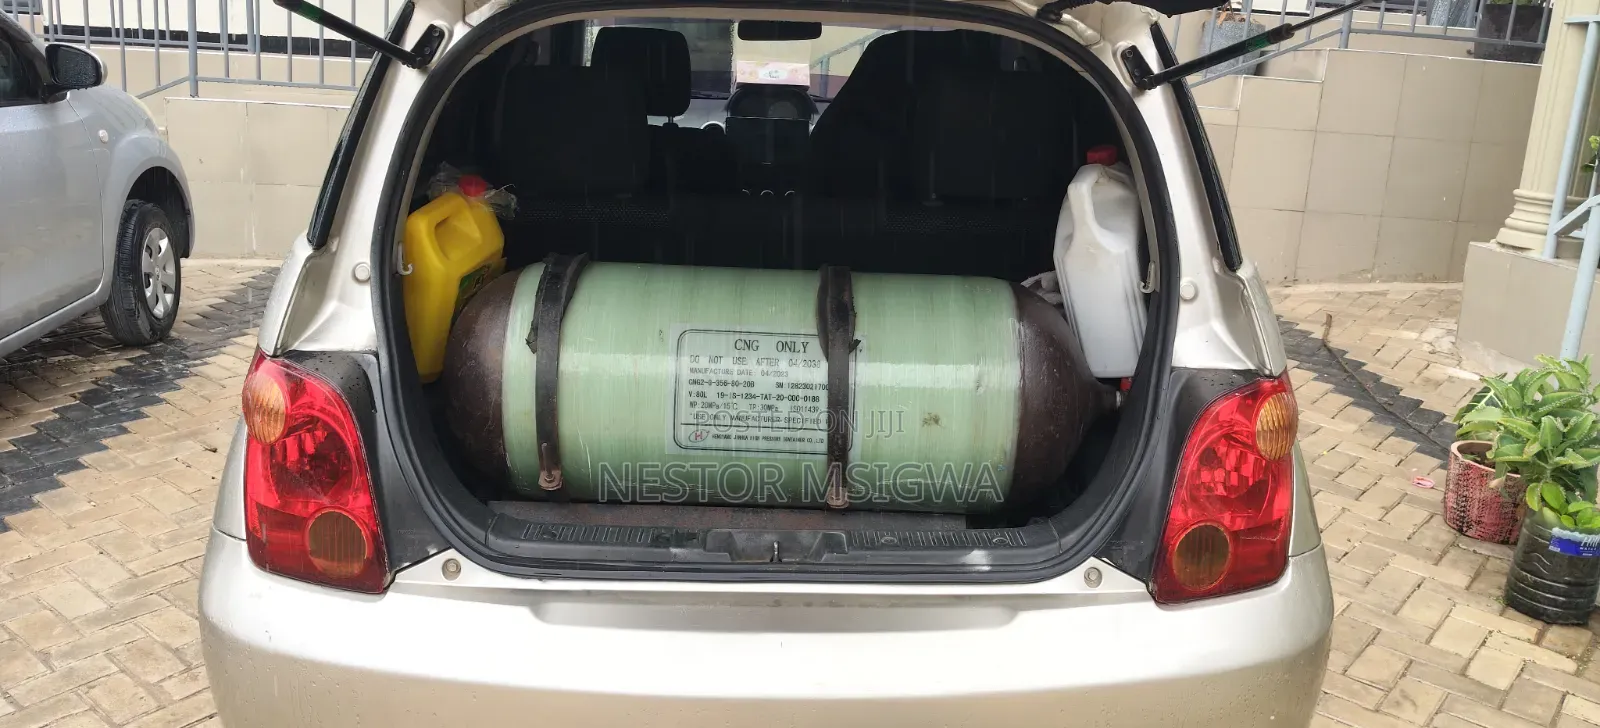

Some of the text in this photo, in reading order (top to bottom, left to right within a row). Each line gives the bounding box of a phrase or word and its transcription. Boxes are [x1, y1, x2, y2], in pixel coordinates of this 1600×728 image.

[734, 338, 810, 353] CNG ONLY
[689, 354, 700, 364] DO
[708, 355, 723, 364] NOT
[732, 356, 747, 366] USE
[755, 357, 780, 367] AFTER
[689, 367, 734, 376] MANUFACTURE
[760, 370, 789, 378] 04/2023
[709, 413, 727, 421] ONLY
